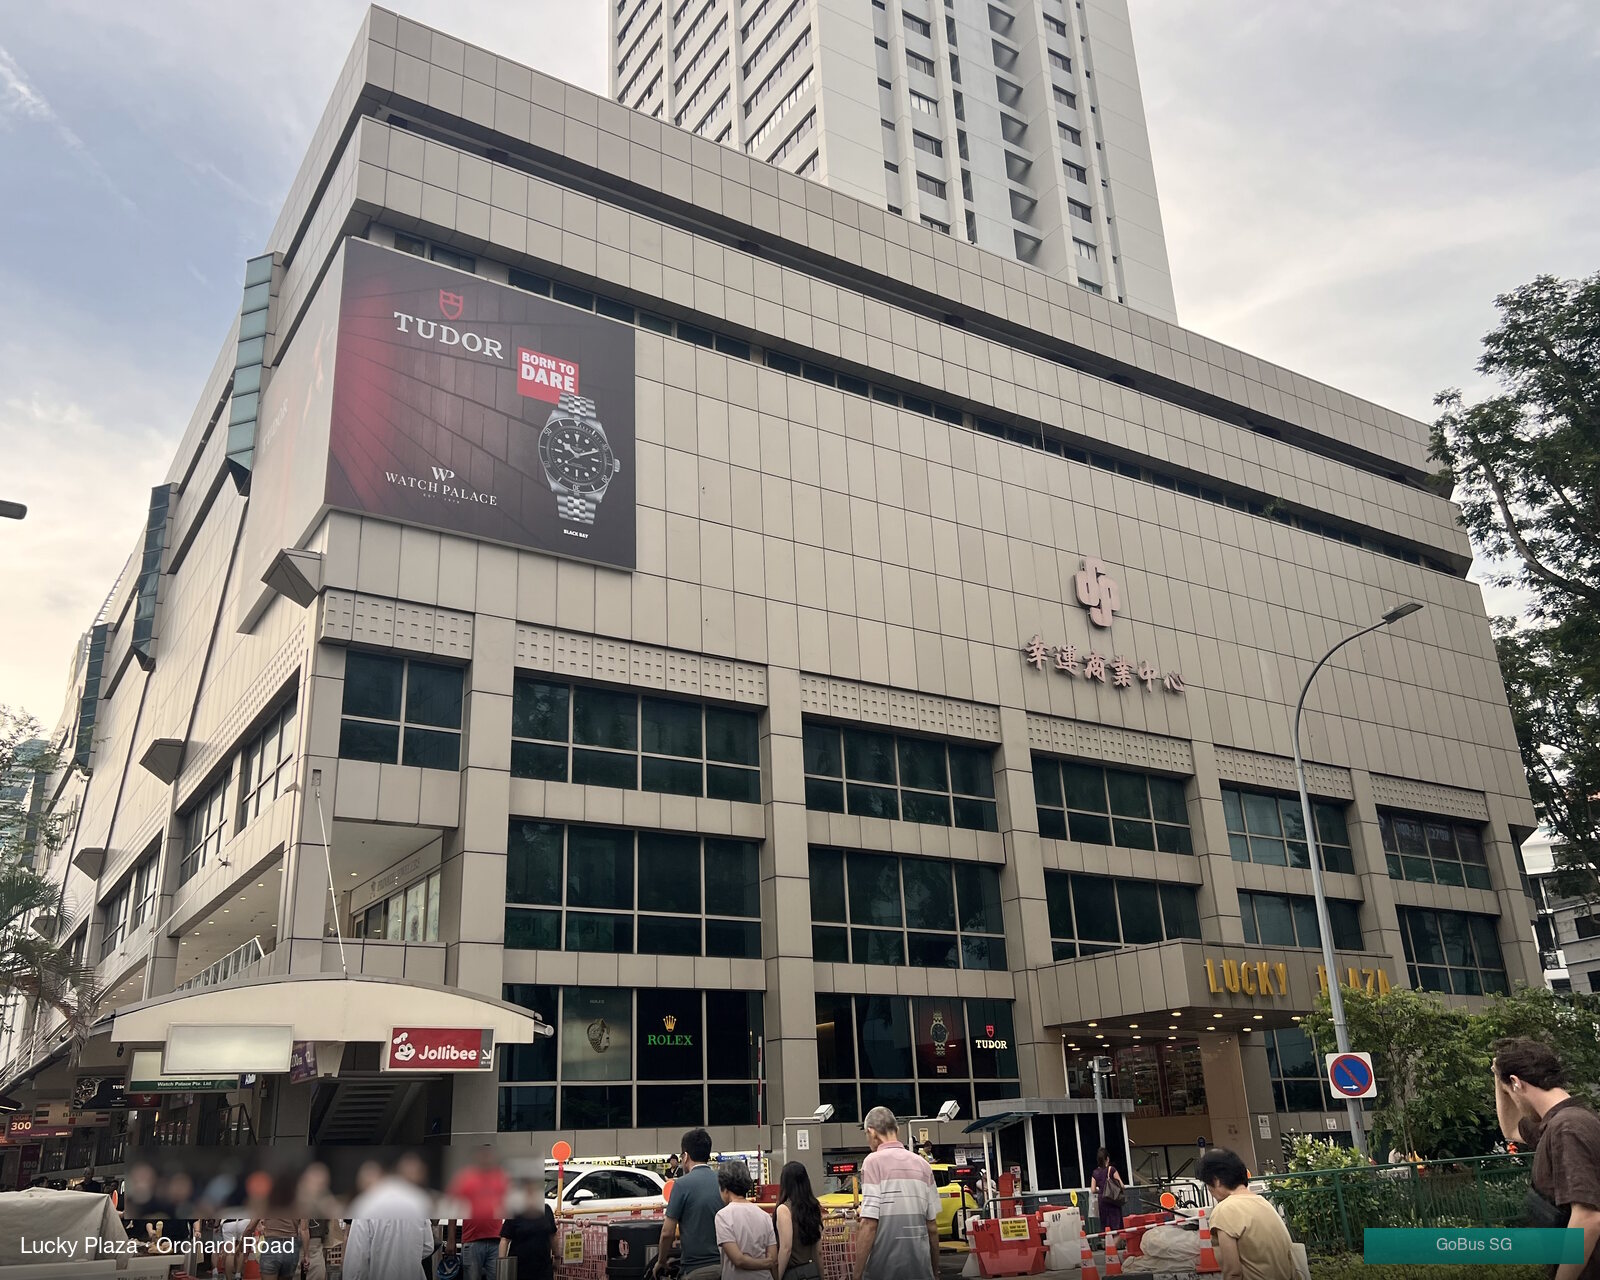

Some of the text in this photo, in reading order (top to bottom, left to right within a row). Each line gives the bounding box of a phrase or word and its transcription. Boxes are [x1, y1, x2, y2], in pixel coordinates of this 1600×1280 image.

[393, 311, 504, 360] TUDOR
[521, 351, 575, 376] BORN TO
[521, 363, 576, 394] DARE
[385, 471, 438, 494] WATCH
[442, 484, 498, 506] PALACE
[563, 529, 579, 537] BLACK
[1022, 634, 1185, 693] 幸運商業中心
[1205, 958, 1392, 997] LUCKY PAZA
[647, 1034, 694, 1046] ROLEX
[975, 1039, 1008, 1050] TUDOR
[418, 1044, 477, 1060] Jollibee
[10, 1121, 32, 1131] 300
[635, 1157, 669, 1165] MONEY
[1051, 1213, 1062, 1223] OKP
[975, 1223, 991, 1233] OKP
